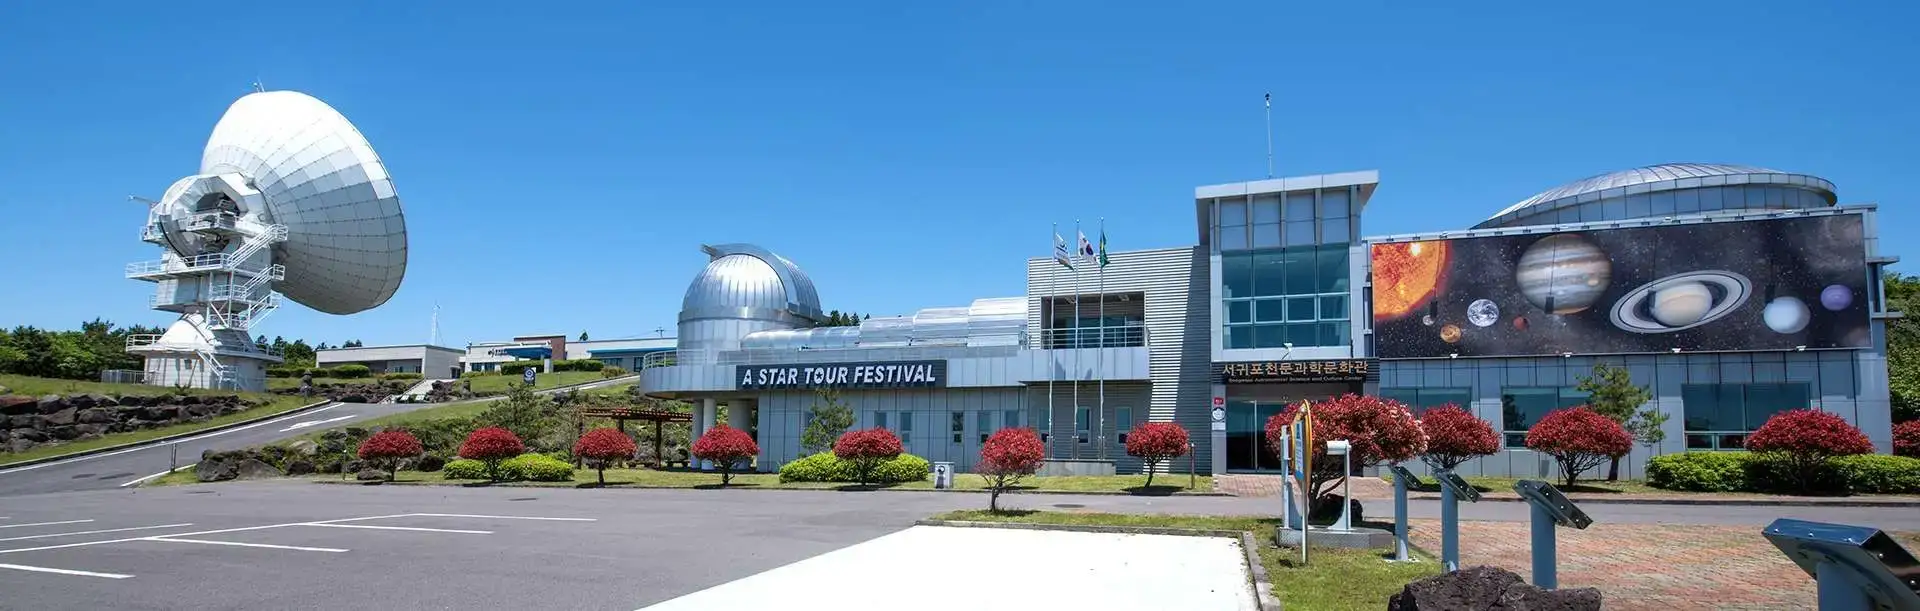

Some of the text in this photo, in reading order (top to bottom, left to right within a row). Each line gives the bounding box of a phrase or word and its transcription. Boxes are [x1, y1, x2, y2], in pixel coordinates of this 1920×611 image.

[743, 364, 936, 385] A STAR TOUR FESTIVAL
[1222, 361, 1369, 376] 서귀포천문과학문화관
